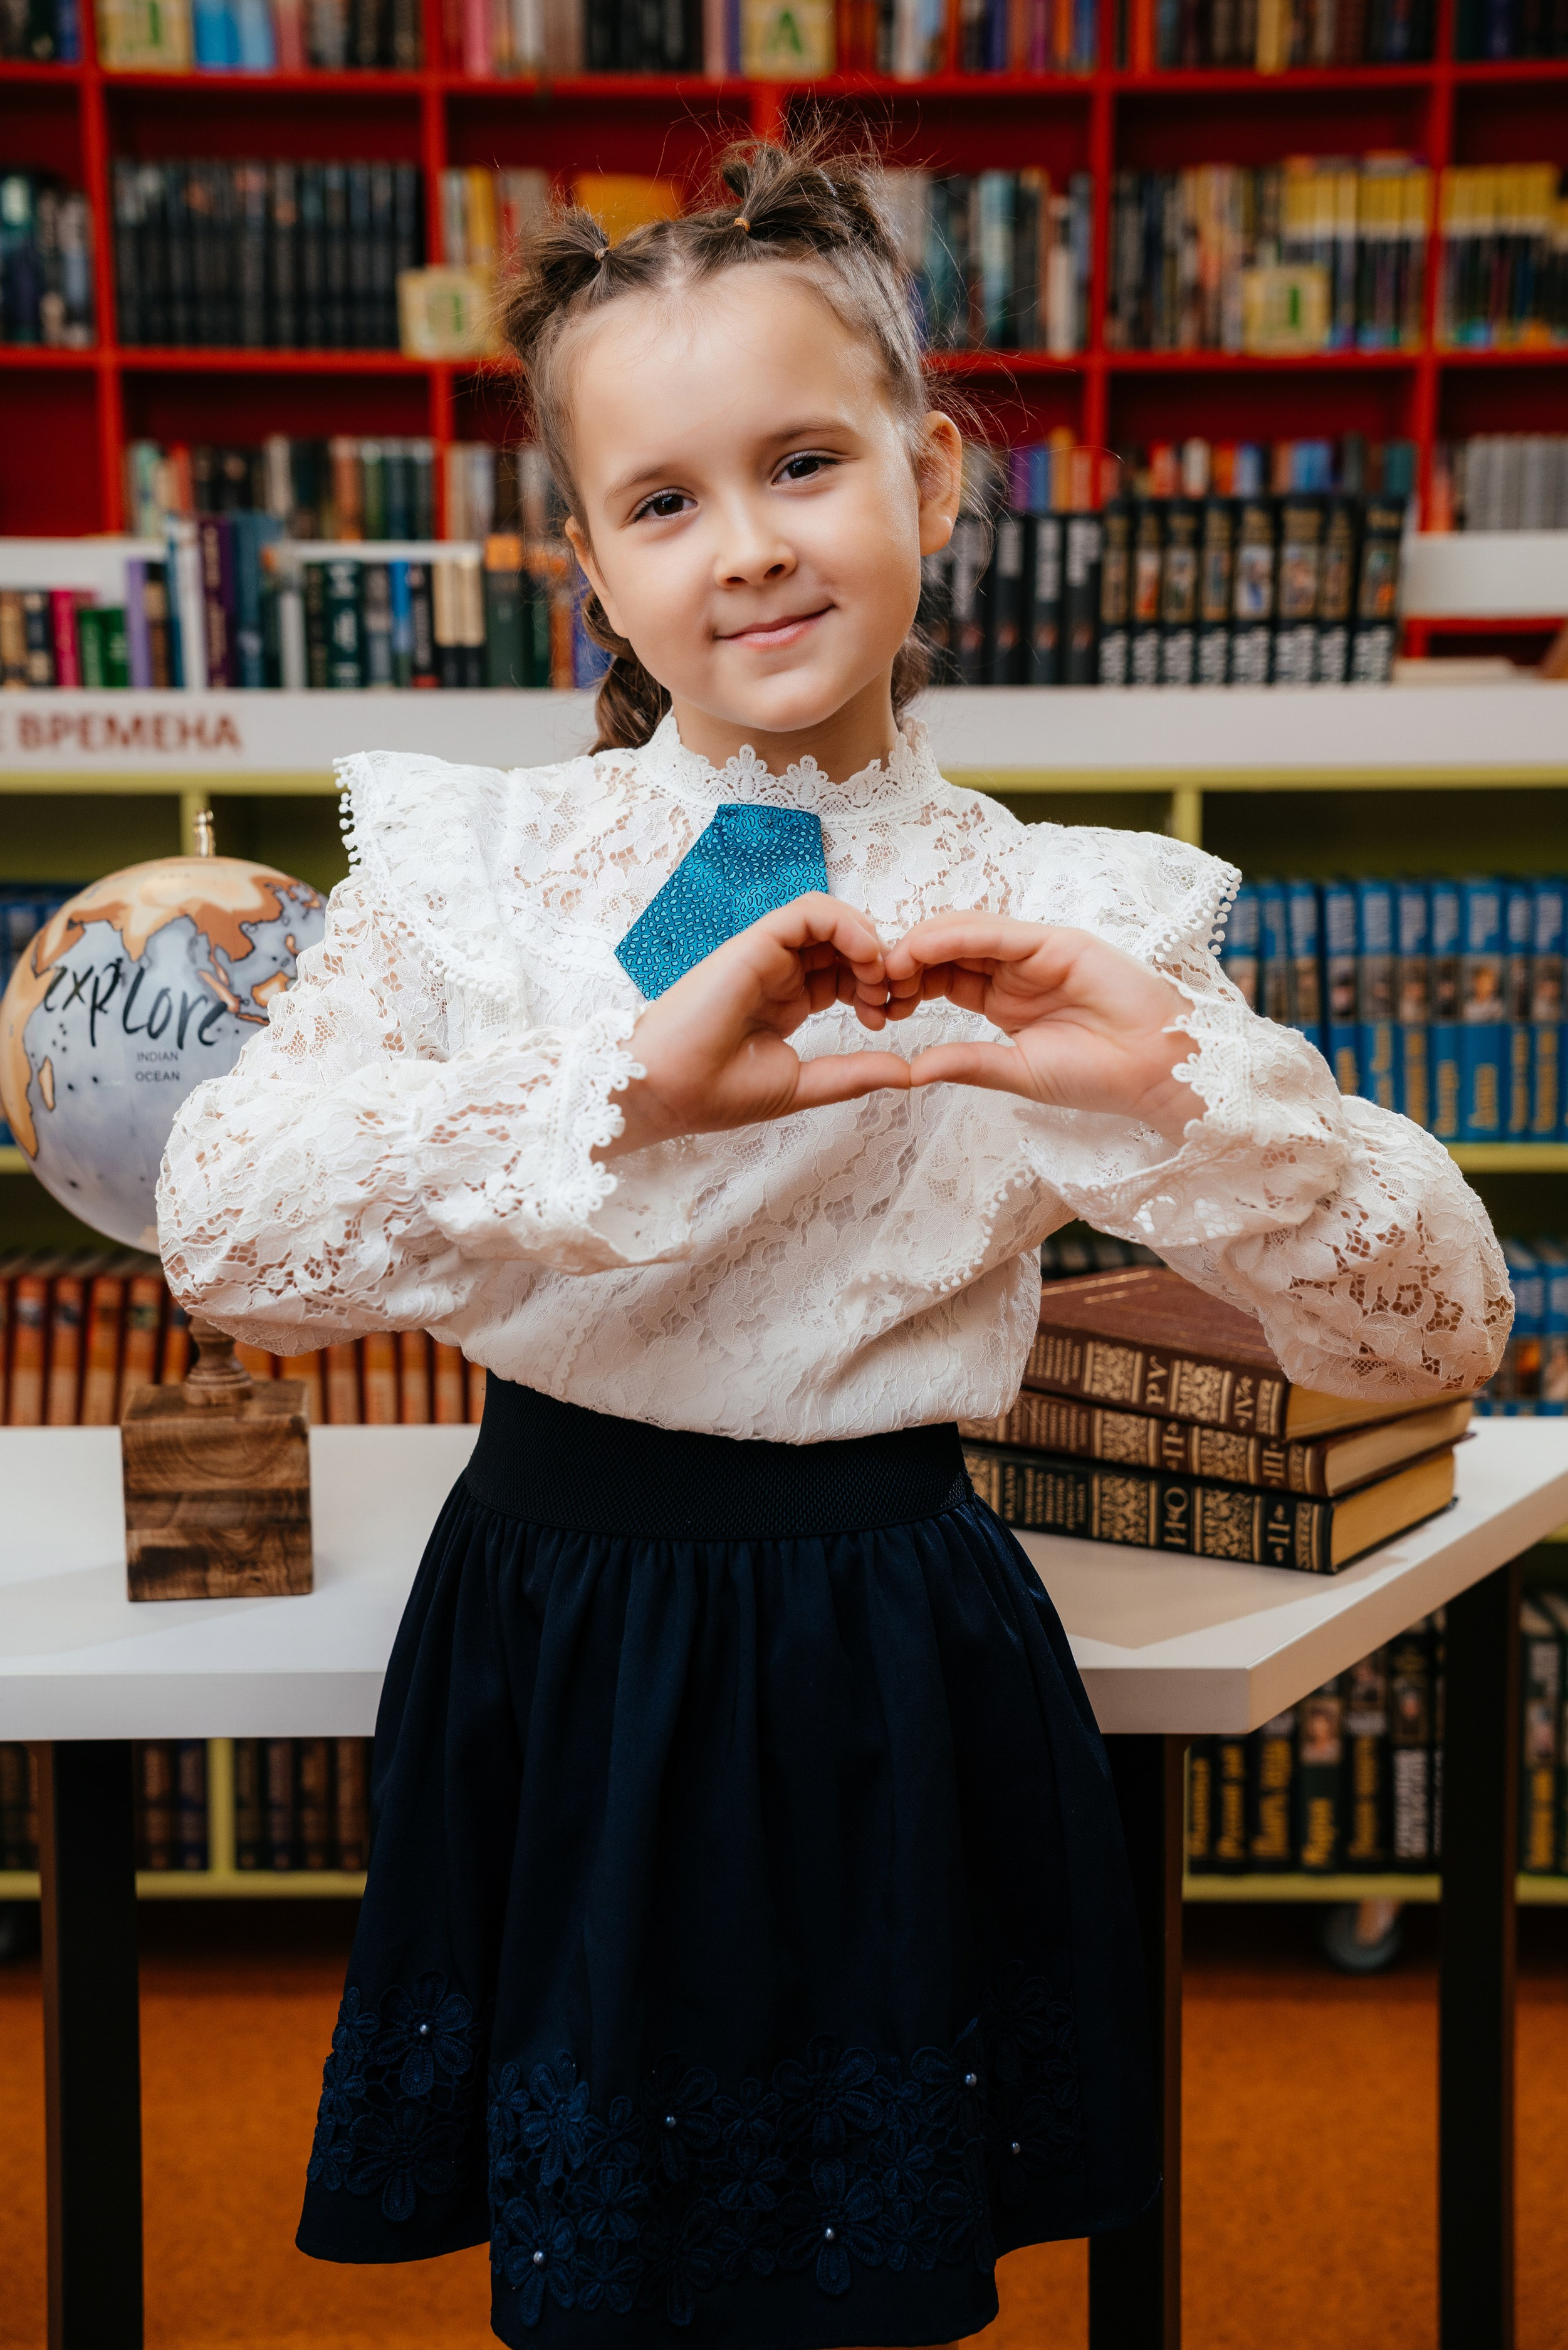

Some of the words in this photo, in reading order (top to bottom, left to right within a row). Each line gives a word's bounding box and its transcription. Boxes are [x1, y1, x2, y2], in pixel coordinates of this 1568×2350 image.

[17, 710, 245, 751] ВРЕМЕНА
[137, 1052, 179, 1062] INDIAN
[135, 1070, 180, 1082] OCEAN
